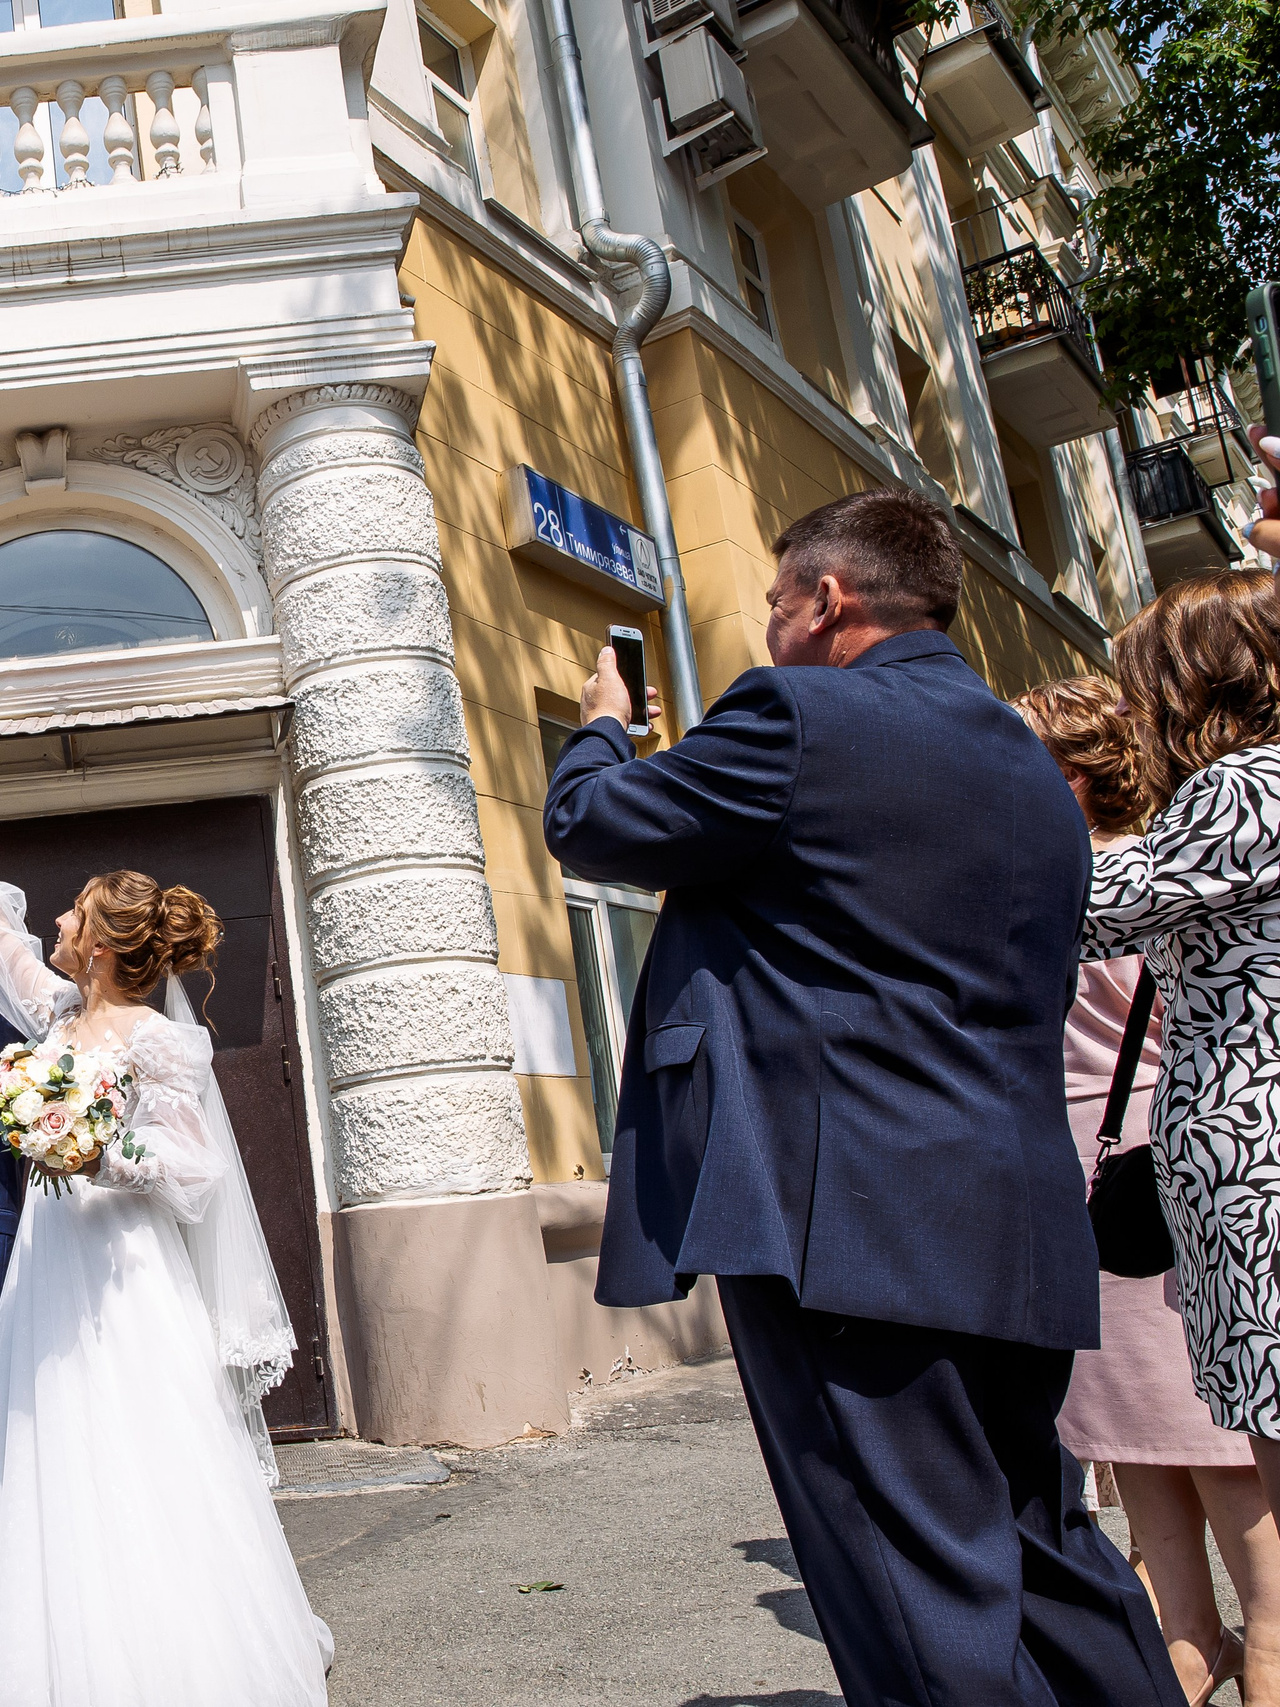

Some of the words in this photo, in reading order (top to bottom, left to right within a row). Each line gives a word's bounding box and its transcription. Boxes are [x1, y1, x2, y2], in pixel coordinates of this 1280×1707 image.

[533, 502, 564, 548] 28
[566, 531, 636, 584] Тимирязева
[612, 542, 632, 561] улица
